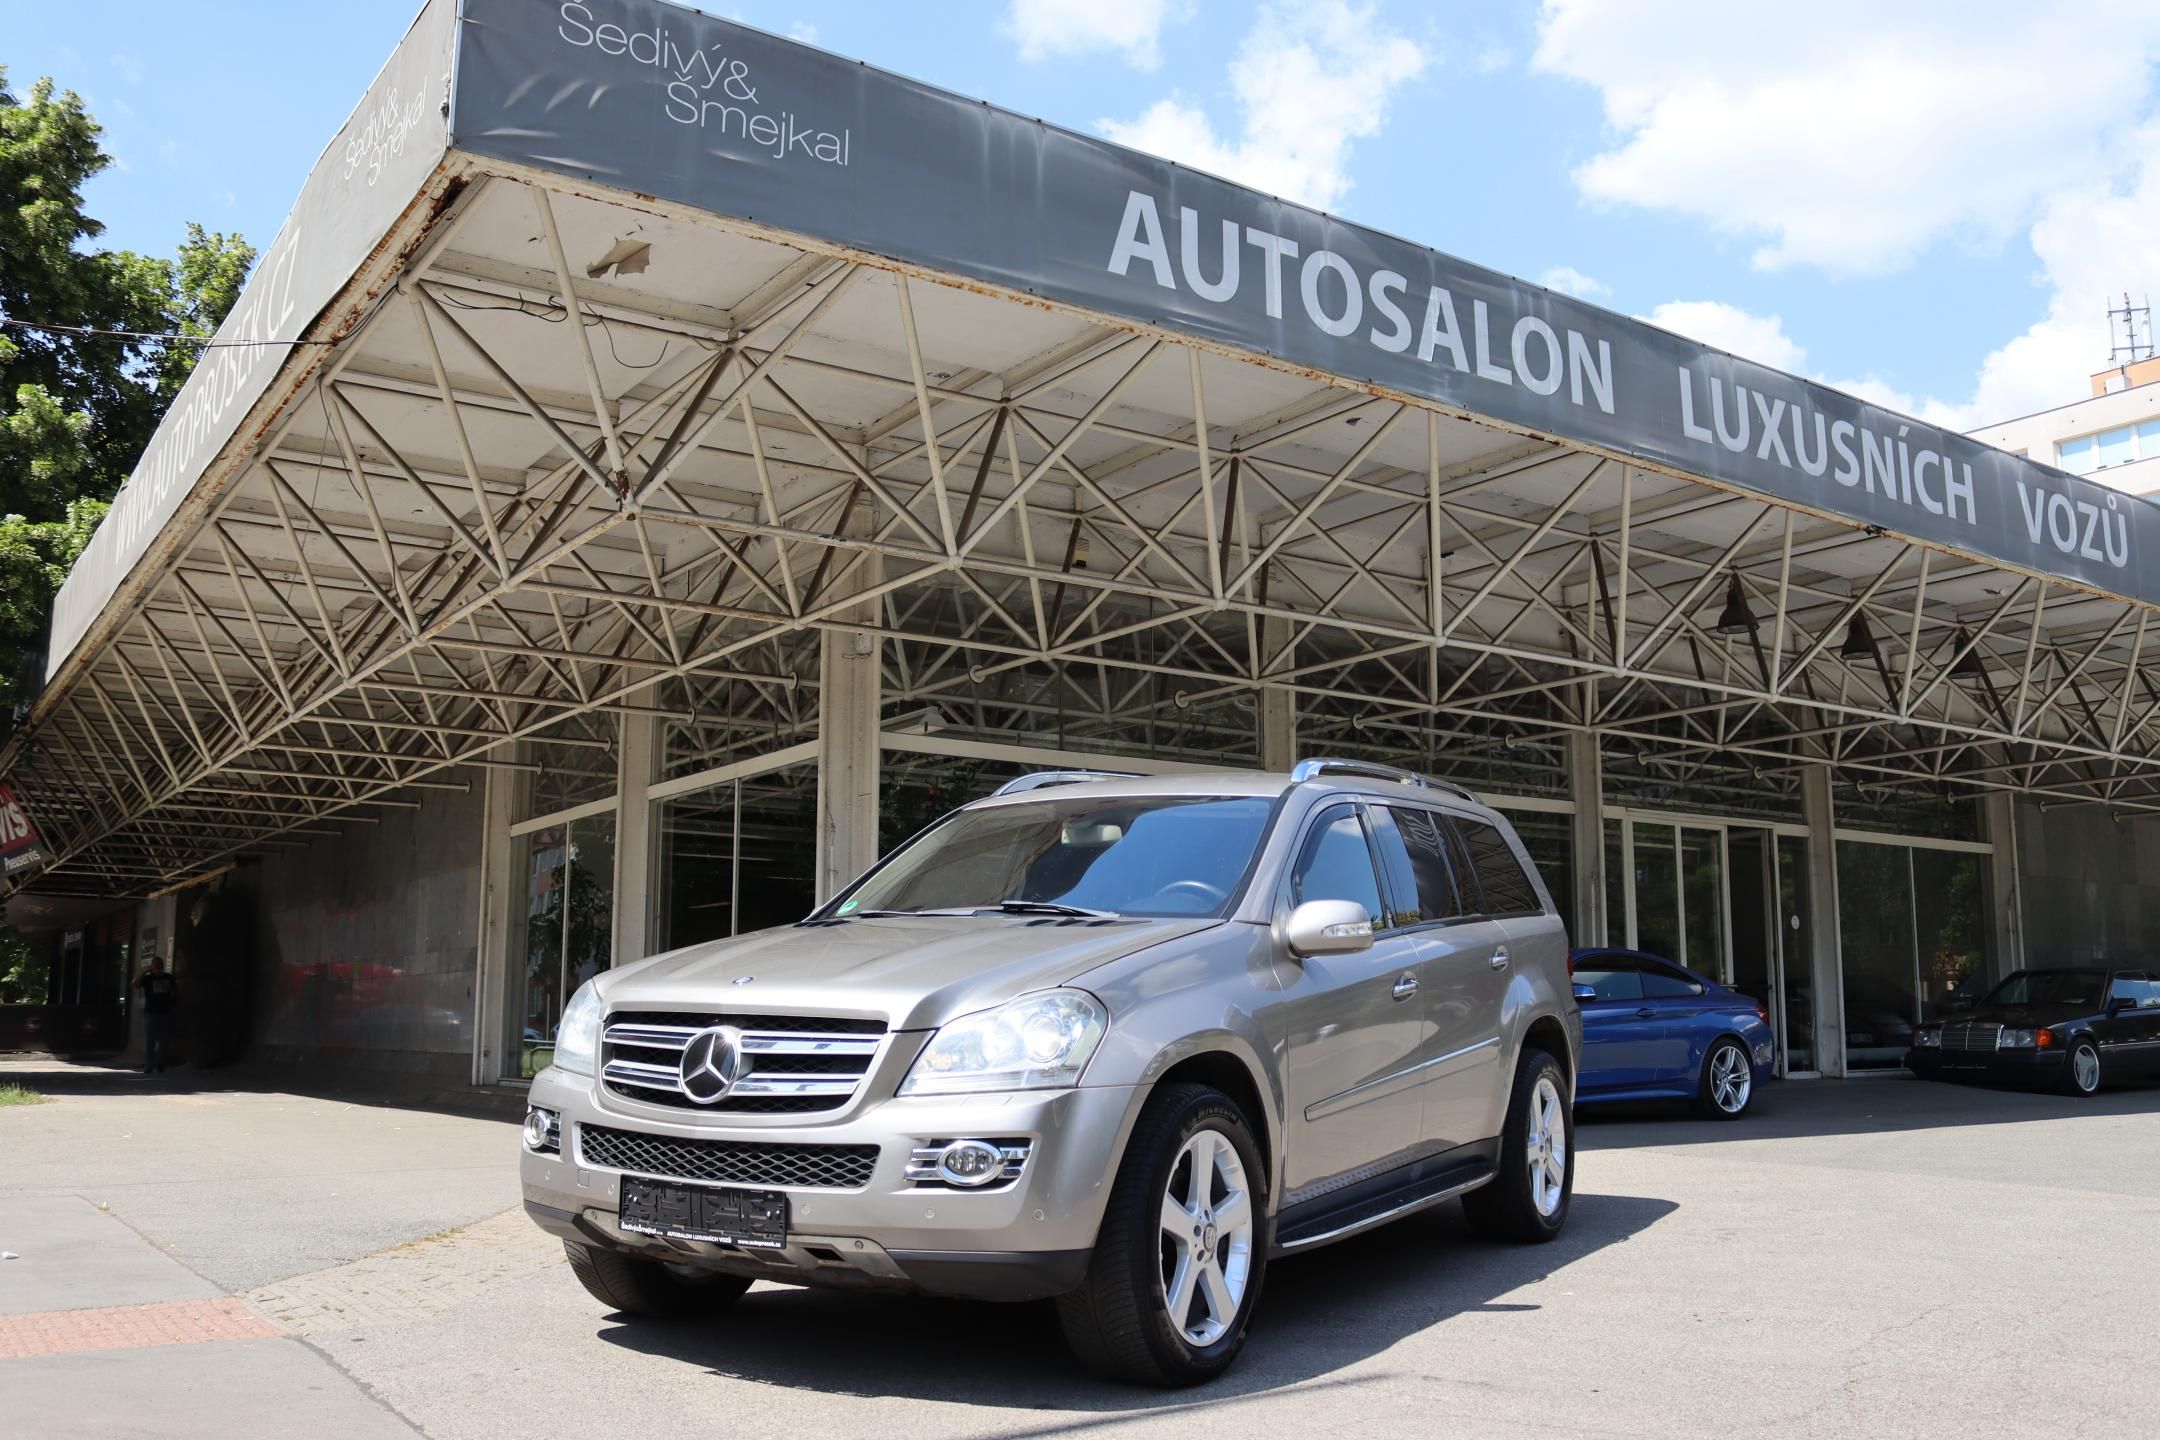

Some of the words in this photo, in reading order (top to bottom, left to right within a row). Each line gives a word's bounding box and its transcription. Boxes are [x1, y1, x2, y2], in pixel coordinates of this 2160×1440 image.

[368, 75, 427, 187] Šmejkal
[665, 71, 849, 166] Šmejkal
[1107, 190, 1615, 414] AUTOSALON
[1678, 366, 1977, 525] LUXUSNÍCH
[2016, 481, 2129, 568] VOZŮ
[666, 1230, 692, 1240] AUTOSALON
